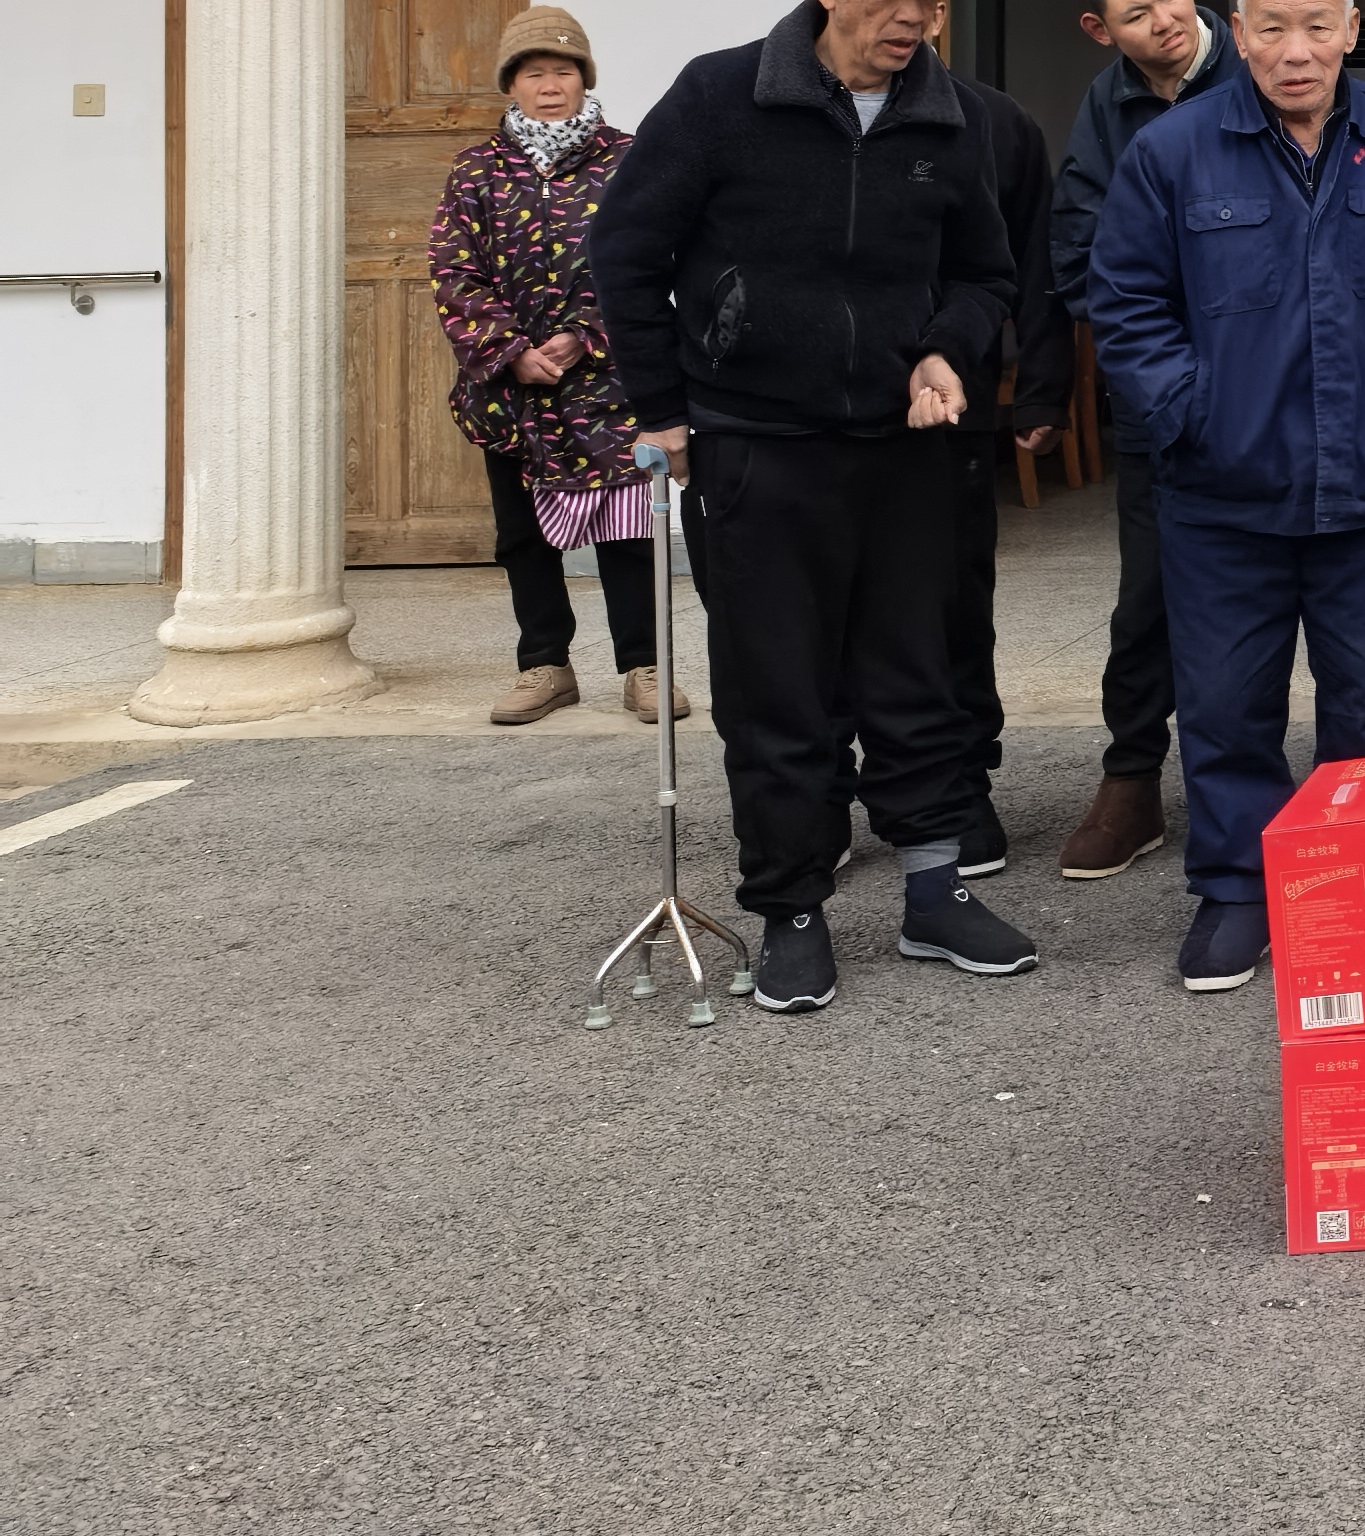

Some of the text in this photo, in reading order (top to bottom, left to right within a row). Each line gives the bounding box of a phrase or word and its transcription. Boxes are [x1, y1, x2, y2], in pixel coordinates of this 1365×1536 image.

[1296, 843, 1339, 858] 白金牧场
[1315, 1059, 1359, 1072] 白金牧场
